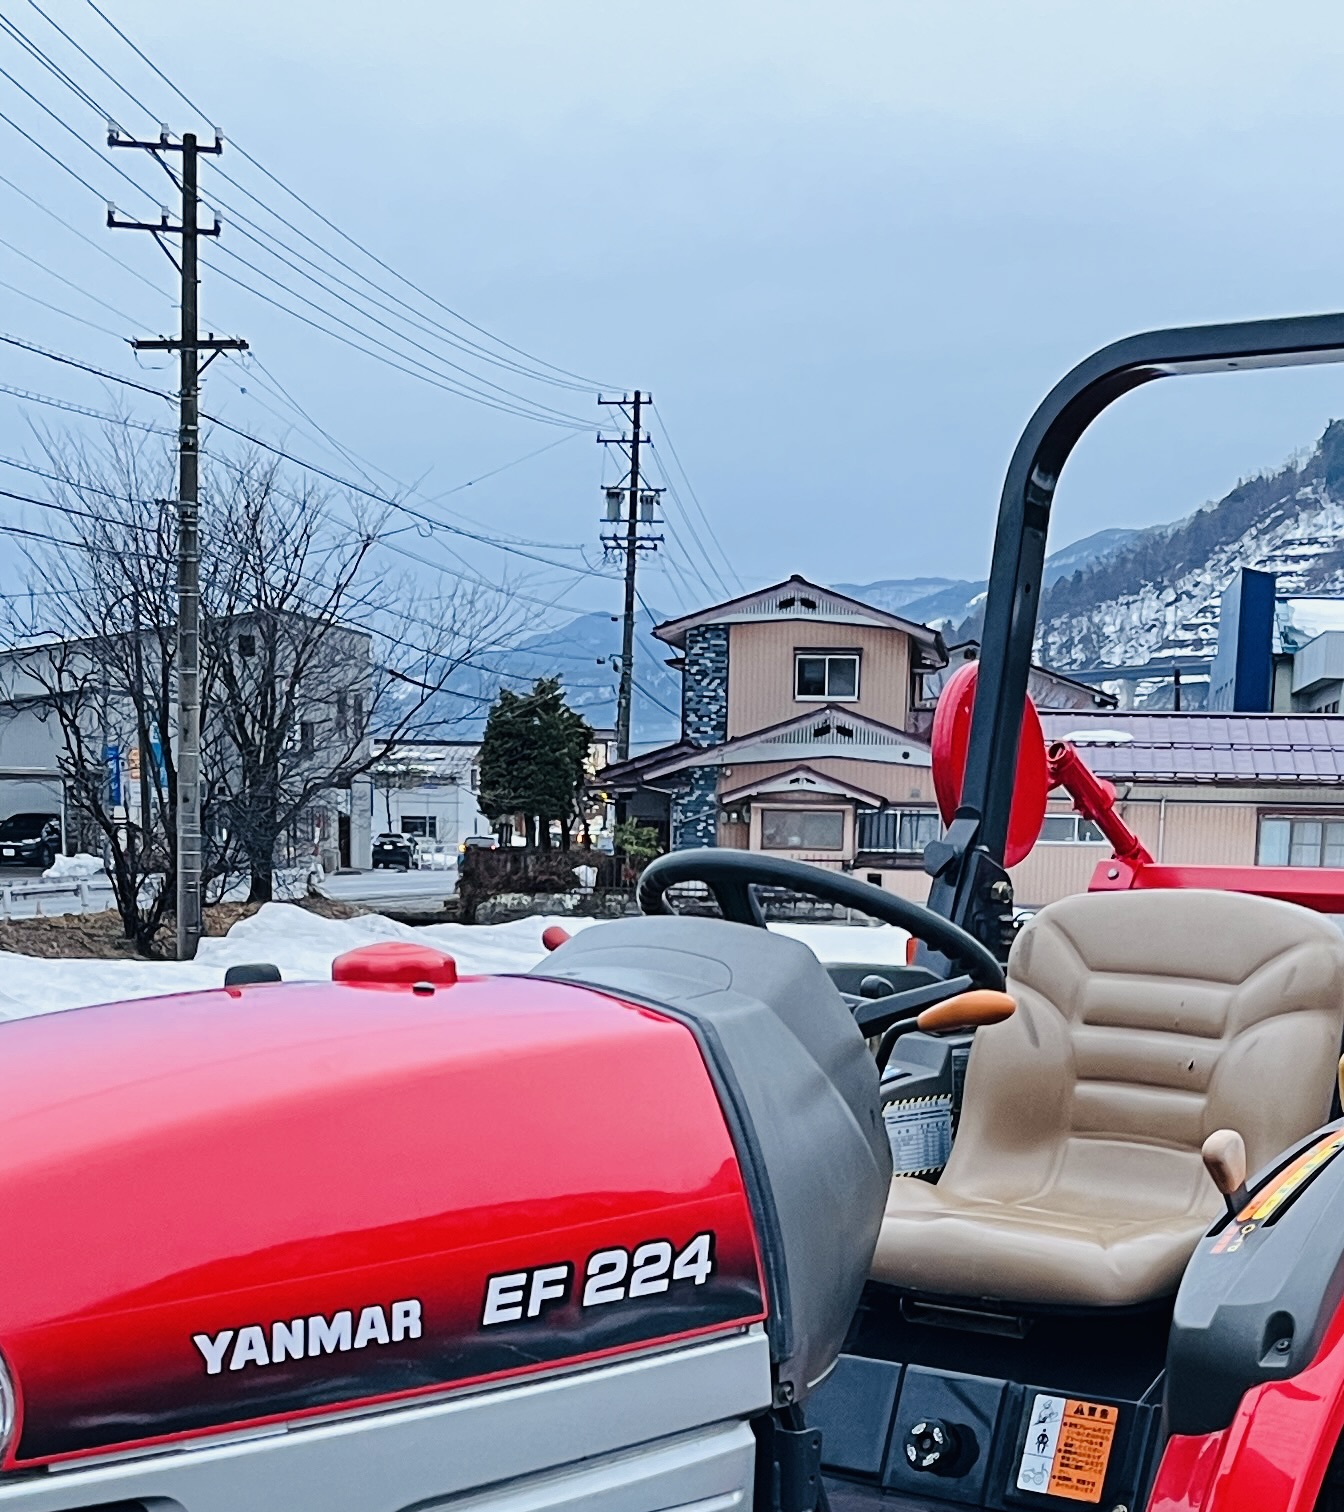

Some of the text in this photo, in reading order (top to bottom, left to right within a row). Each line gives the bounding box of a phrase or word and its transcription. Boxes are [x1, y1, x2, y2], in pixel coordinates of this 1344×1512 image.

[193, 1234, 712, 1375] YANMAR EF 224
